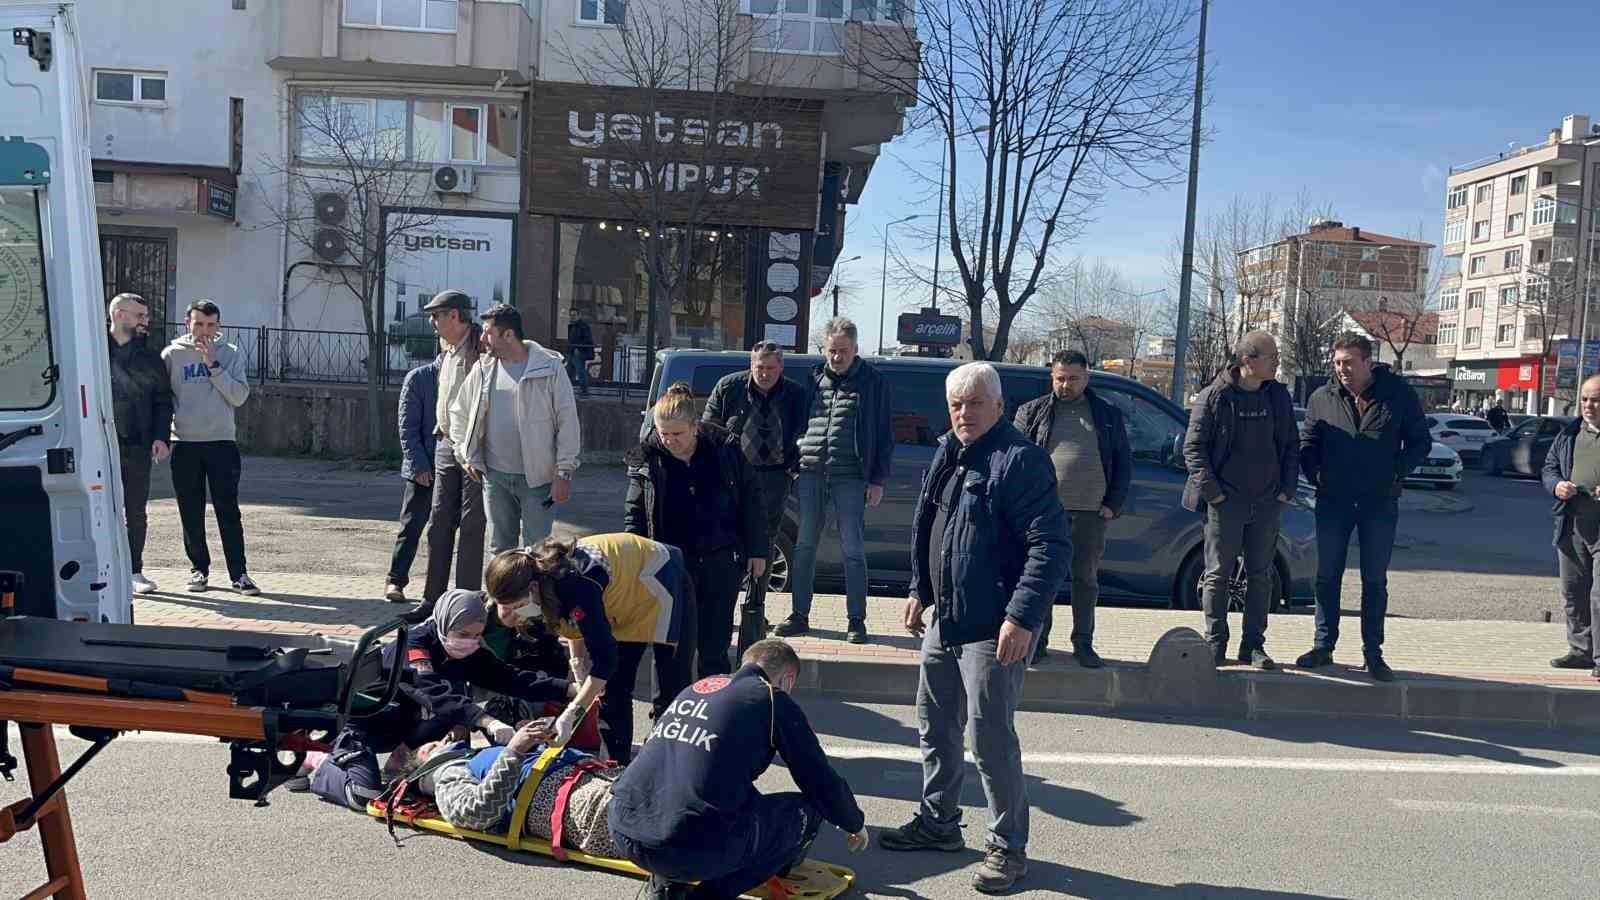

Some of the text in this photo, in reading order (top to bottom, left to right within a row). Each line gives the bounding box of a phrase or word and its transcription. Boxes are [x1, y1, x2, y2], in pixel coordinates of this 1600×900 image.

[568, 111, 783, 149] yatsan
[582, 157, 761, 200] TEMPUR
[404, 234, 490, 251] yatsan
[915, 323, 958, 336] arçelik
[664, 699, 709, 720] ACİL
[652, 718, 718, 752] AĞLIK
